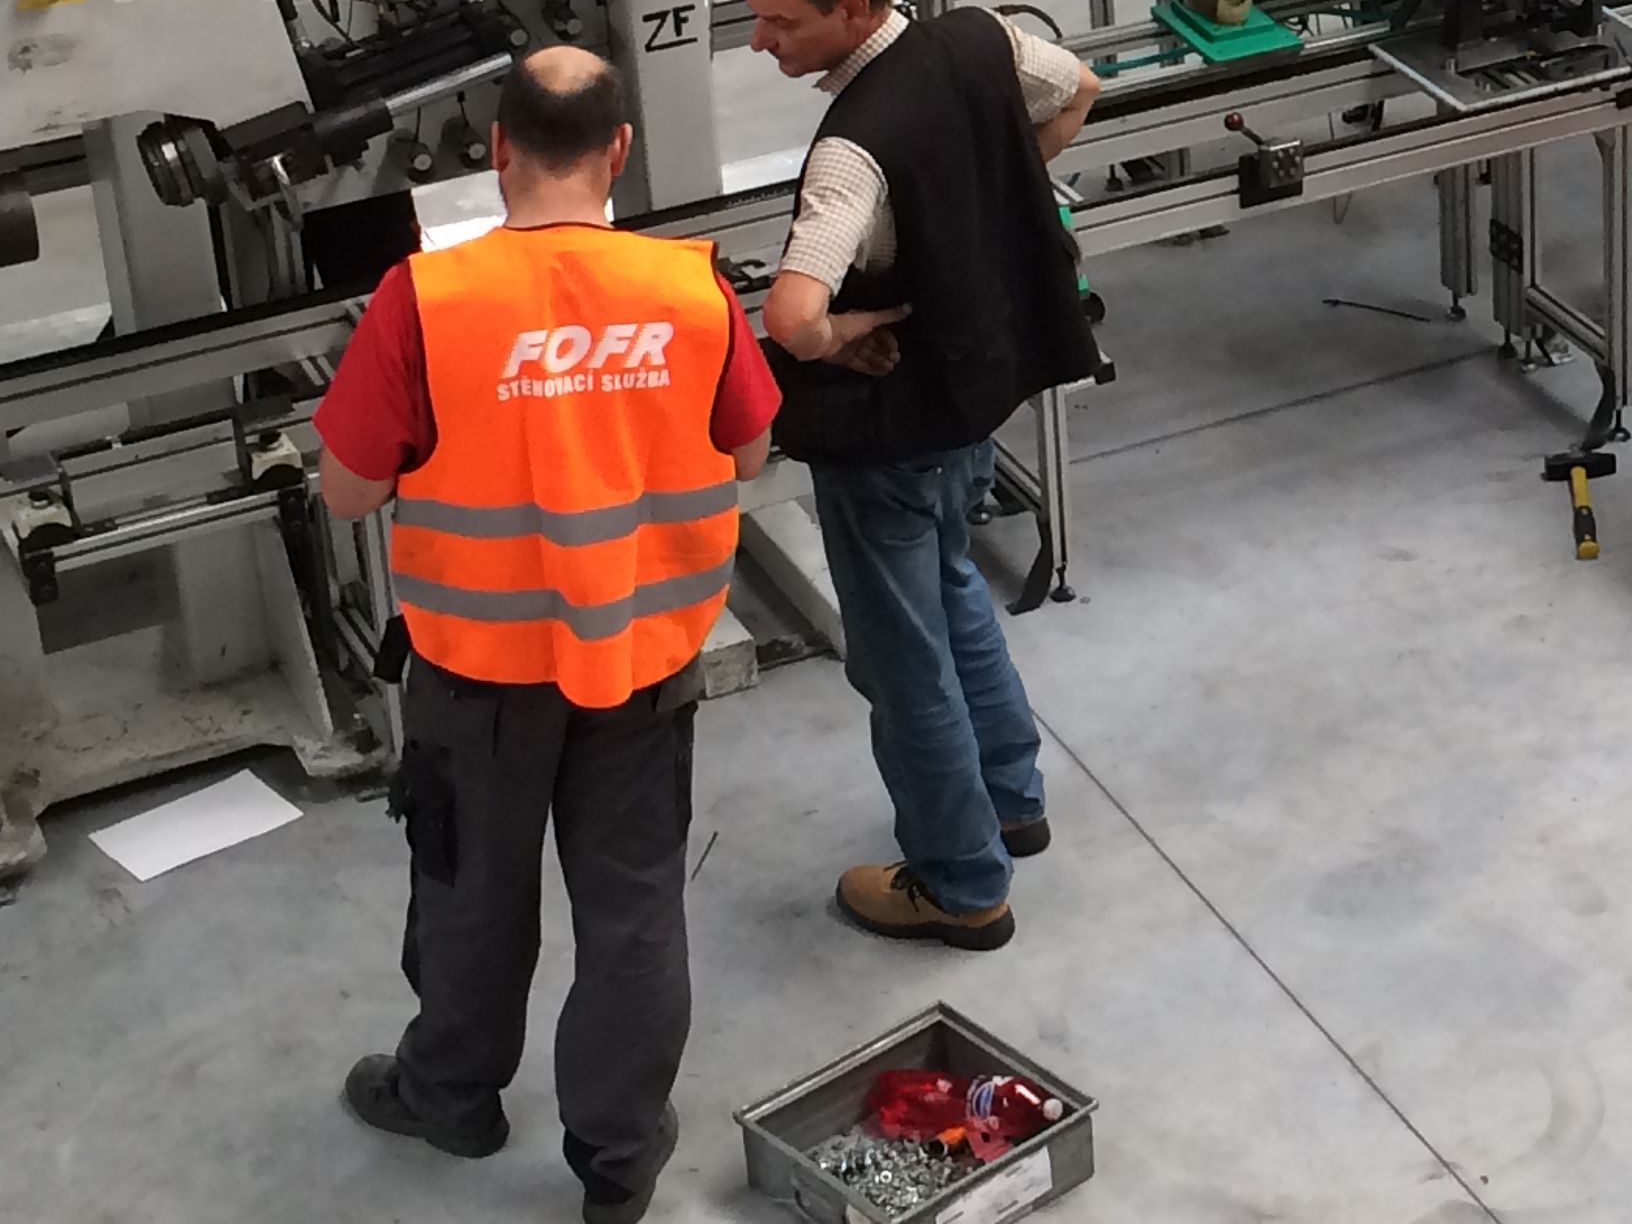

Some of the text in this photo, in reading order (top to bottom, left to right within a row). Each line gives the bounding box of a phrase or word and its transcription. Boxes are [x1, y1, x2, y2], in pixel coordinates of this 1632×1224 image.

[642, 4, 698, 53] ZF
[501, 321, 674, 380] FOFR
[601, 367, 671, 393] SLUŽBA
